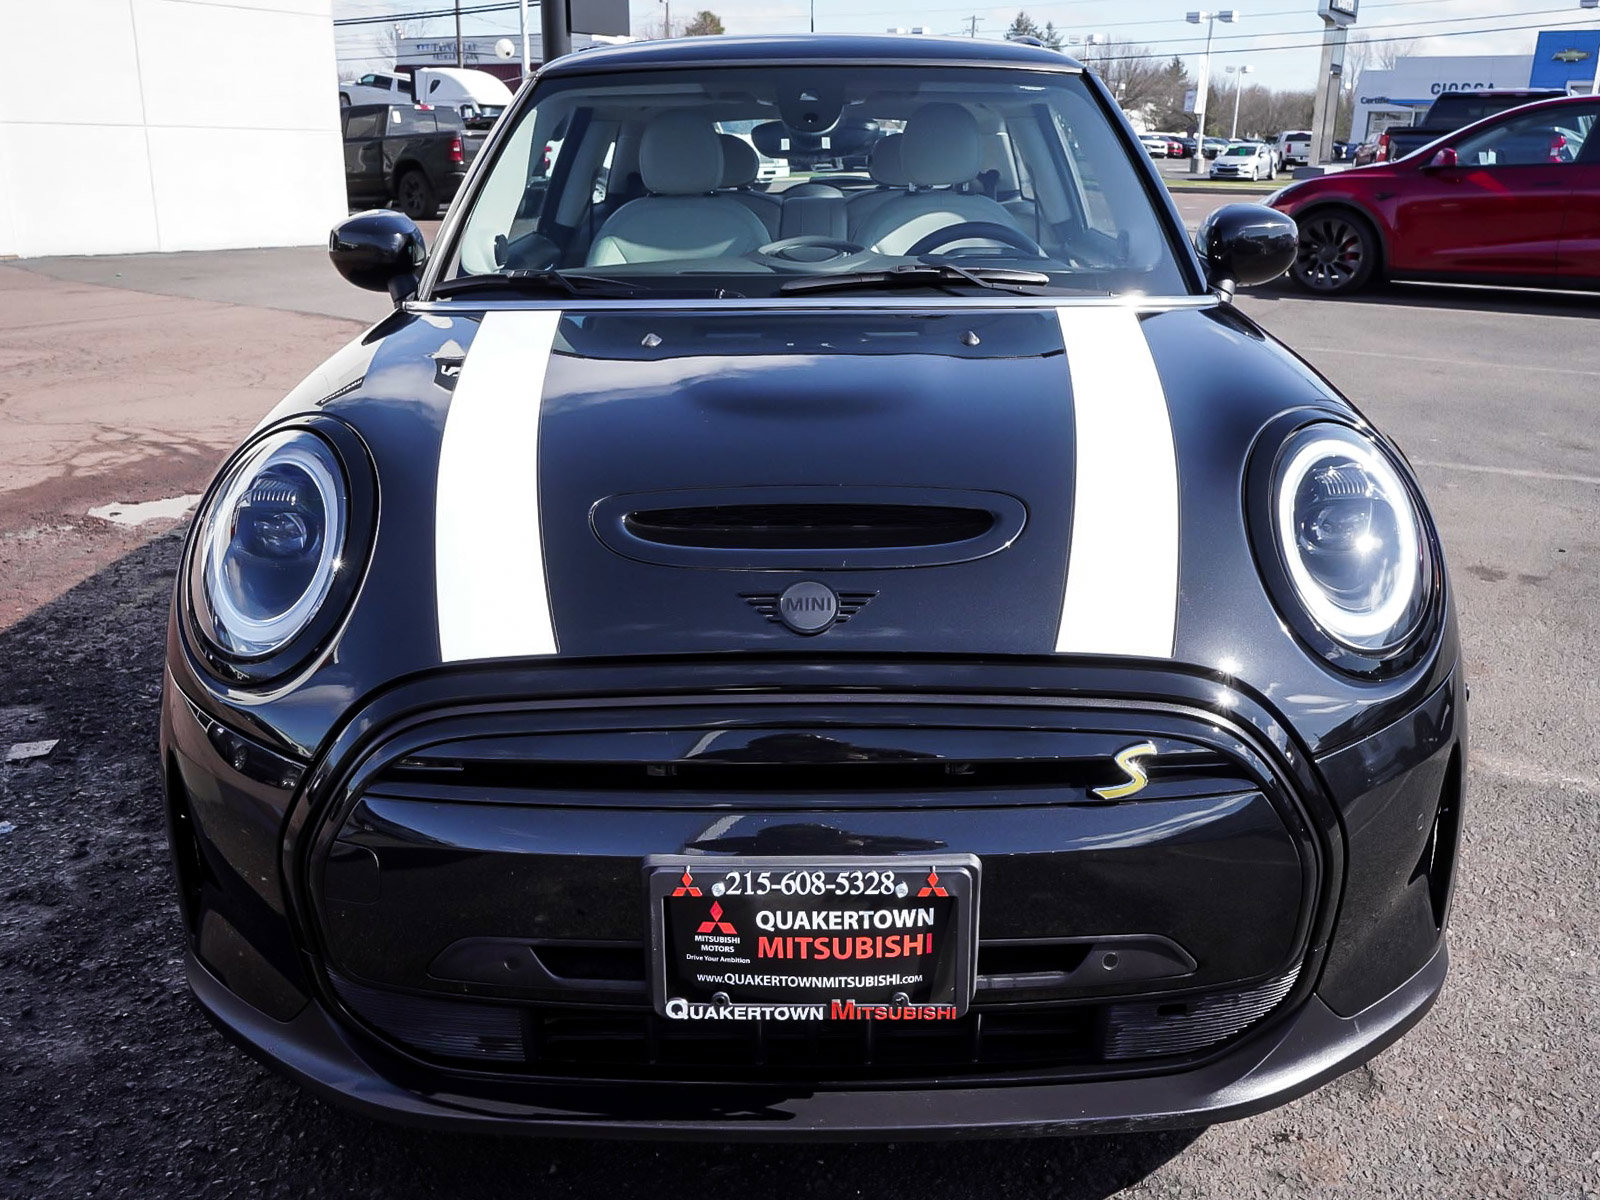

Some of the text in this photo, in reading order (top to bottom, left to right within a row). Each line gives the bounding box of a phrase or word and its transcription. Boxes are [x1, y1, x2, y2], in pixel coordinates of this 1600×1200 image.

[786, 597, 832, 611] MINI
[1092, 740, 1158, 800] S
[725, 870, 897, 896] 215-608-5328
[755, 907, 935, 932] QUAKERTOWN
[694, 935, 741, 945] MITSUBISHI
[700, 944, 735, 953] MOTORS
[757, 932, 933, 960] MITSUBISHI
[686, 953, 704, 961] Drive
[719, 956, 751, 964] Ambition
[665, 997, 957, 1021] QUAKERTOWN MITSUBISHI
